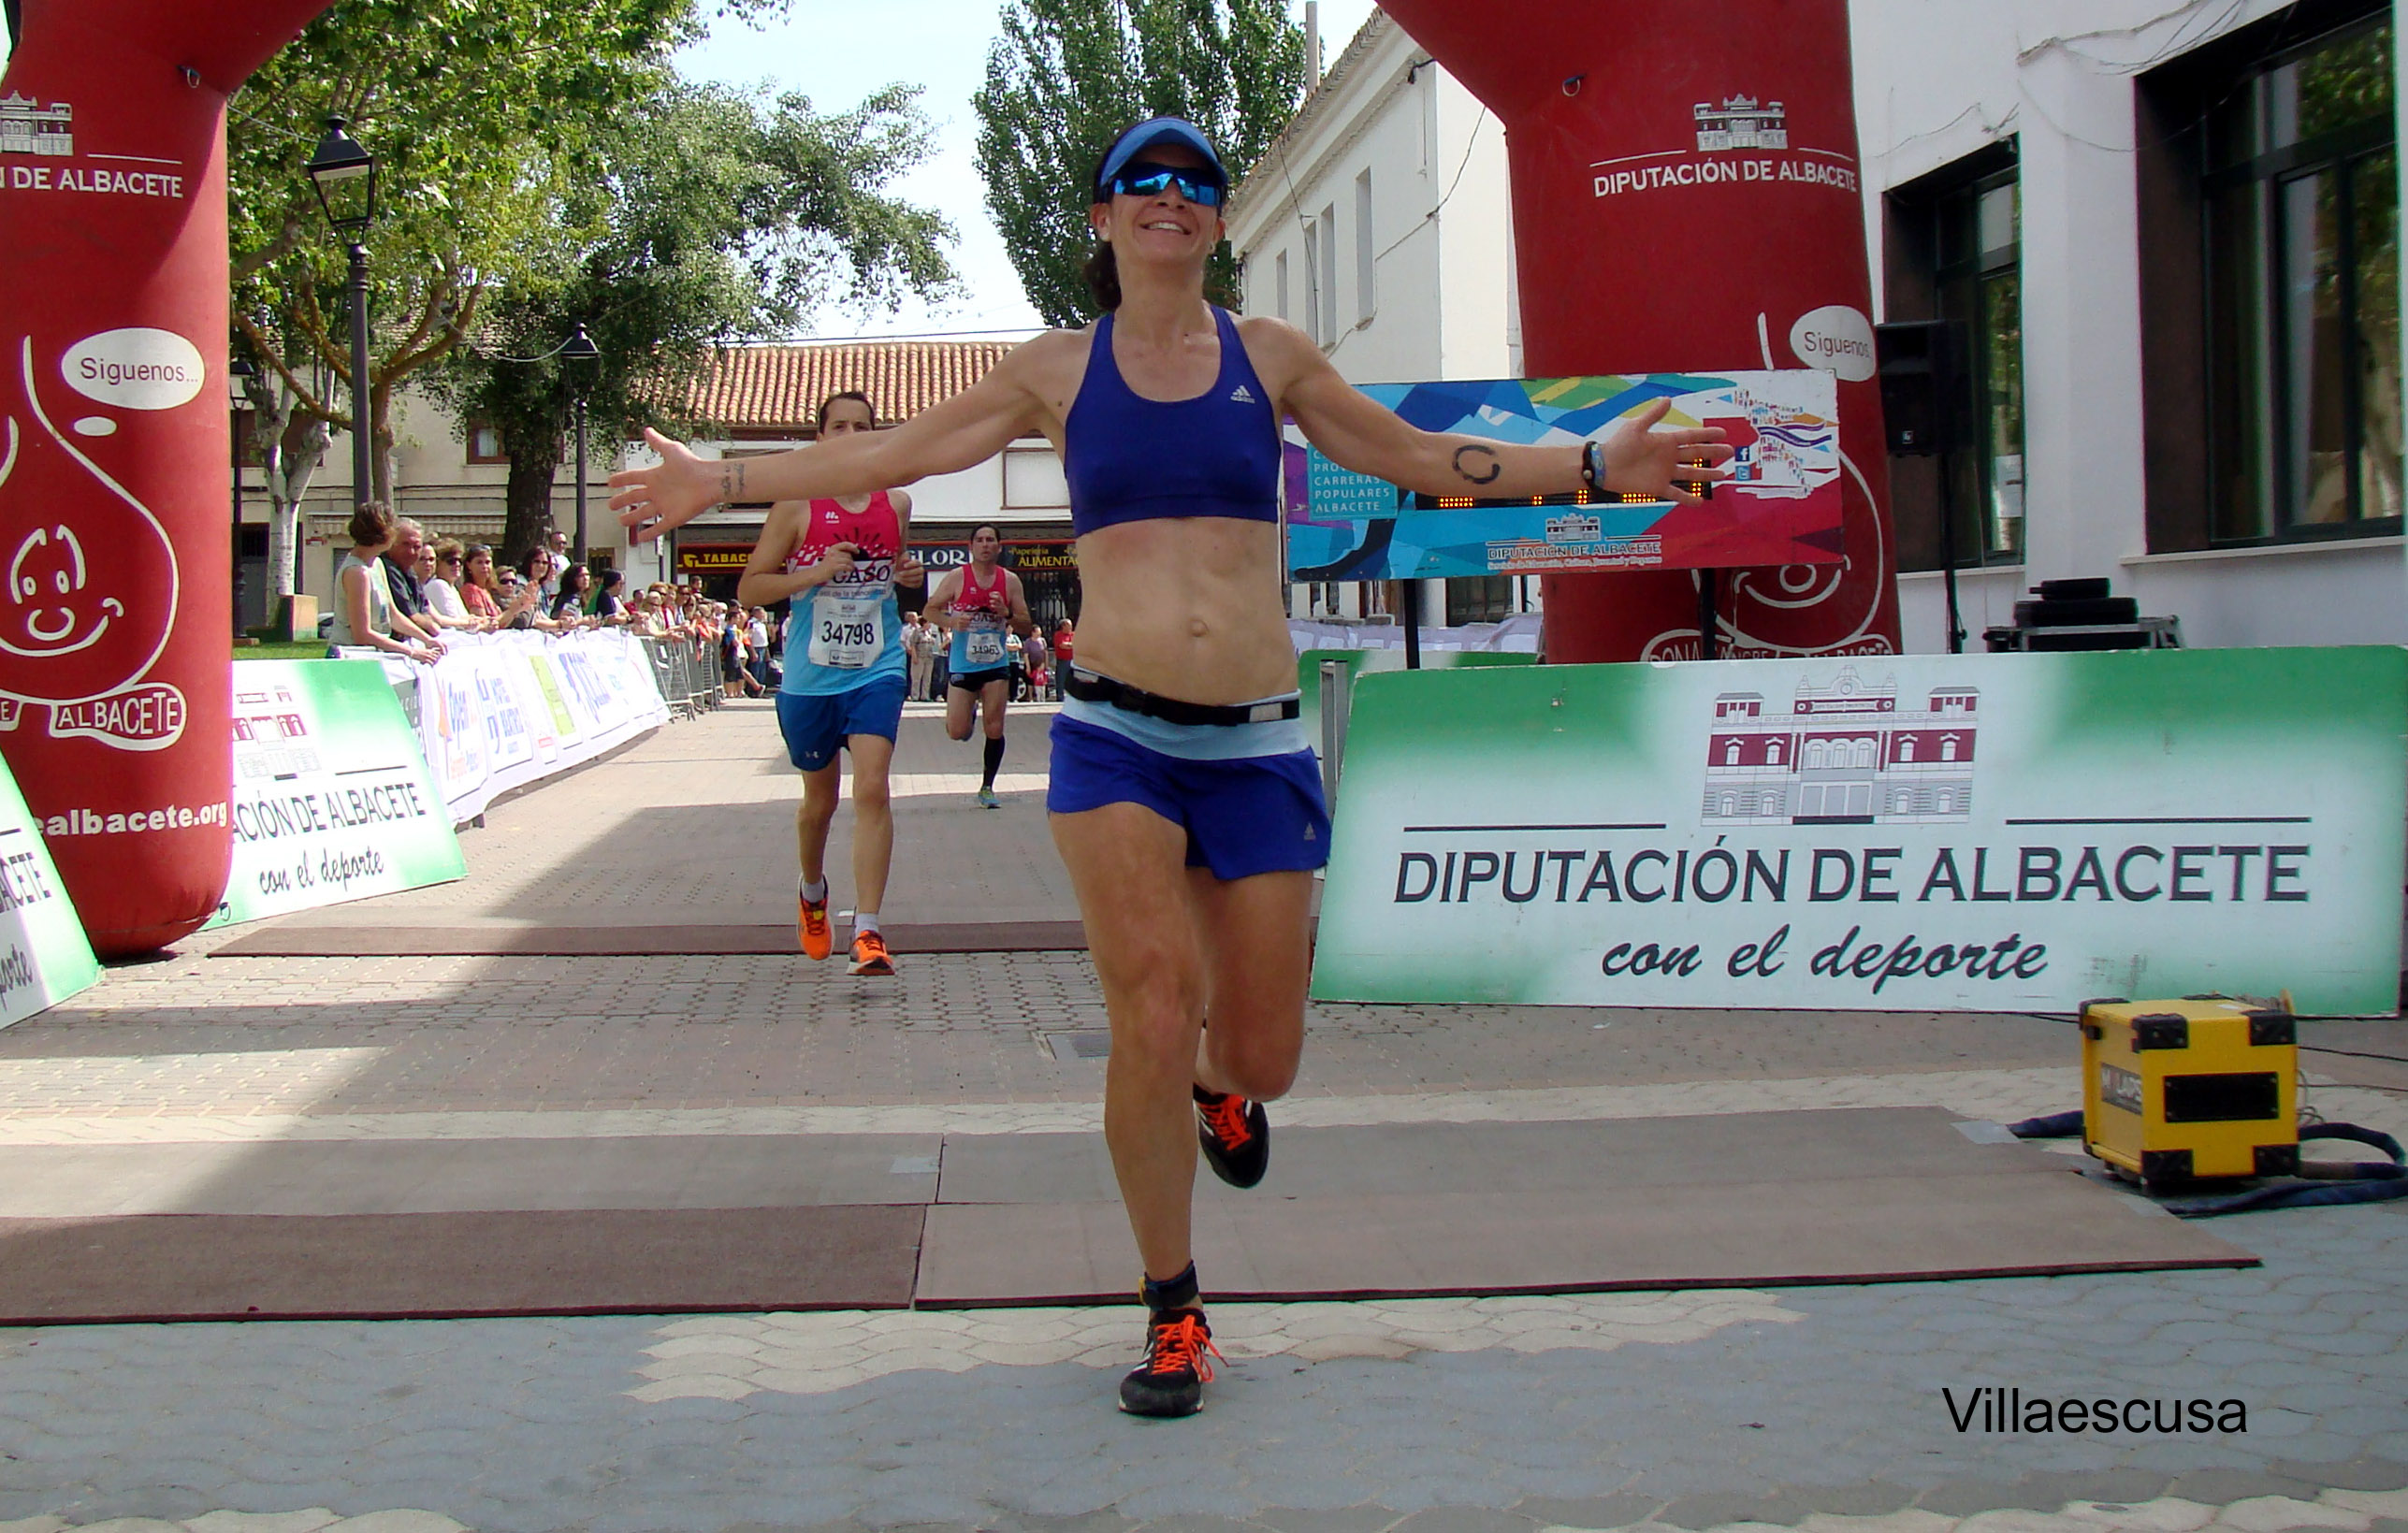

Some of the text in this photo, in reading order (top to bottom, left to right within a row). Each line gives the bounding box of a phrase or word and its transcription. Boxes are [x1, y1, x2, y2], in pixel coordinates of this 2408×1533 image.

[12, 166, 52, 190] DE
[58, 168, 184, 199] ALBACETE
[1593, 157, 1858, 198] DIPUTACIÓN DE ALBACETE
[1314, 475, 1380, 486] CARRERAS
[1314, 487, 1390, 499] POPULARES
[1315, 501, 1381, 513] ALBACETE
[1572, 544, 1588, 557] DE
[1593, 542, 1661, 556] ALBACETE
[821, 620, 875, 646] 34798
[58, 692, 180, 735] ALBACETE
[290, 794, 327, 833] DE
[325, 782, 427, 829] ALBACETE
[259, 846, 384, 895] con el deporte
[1394, 834, 2311, 904] DIPUTACIÓN DE ALBACETE
[1602, 923, 2049, 995] con el deporte
